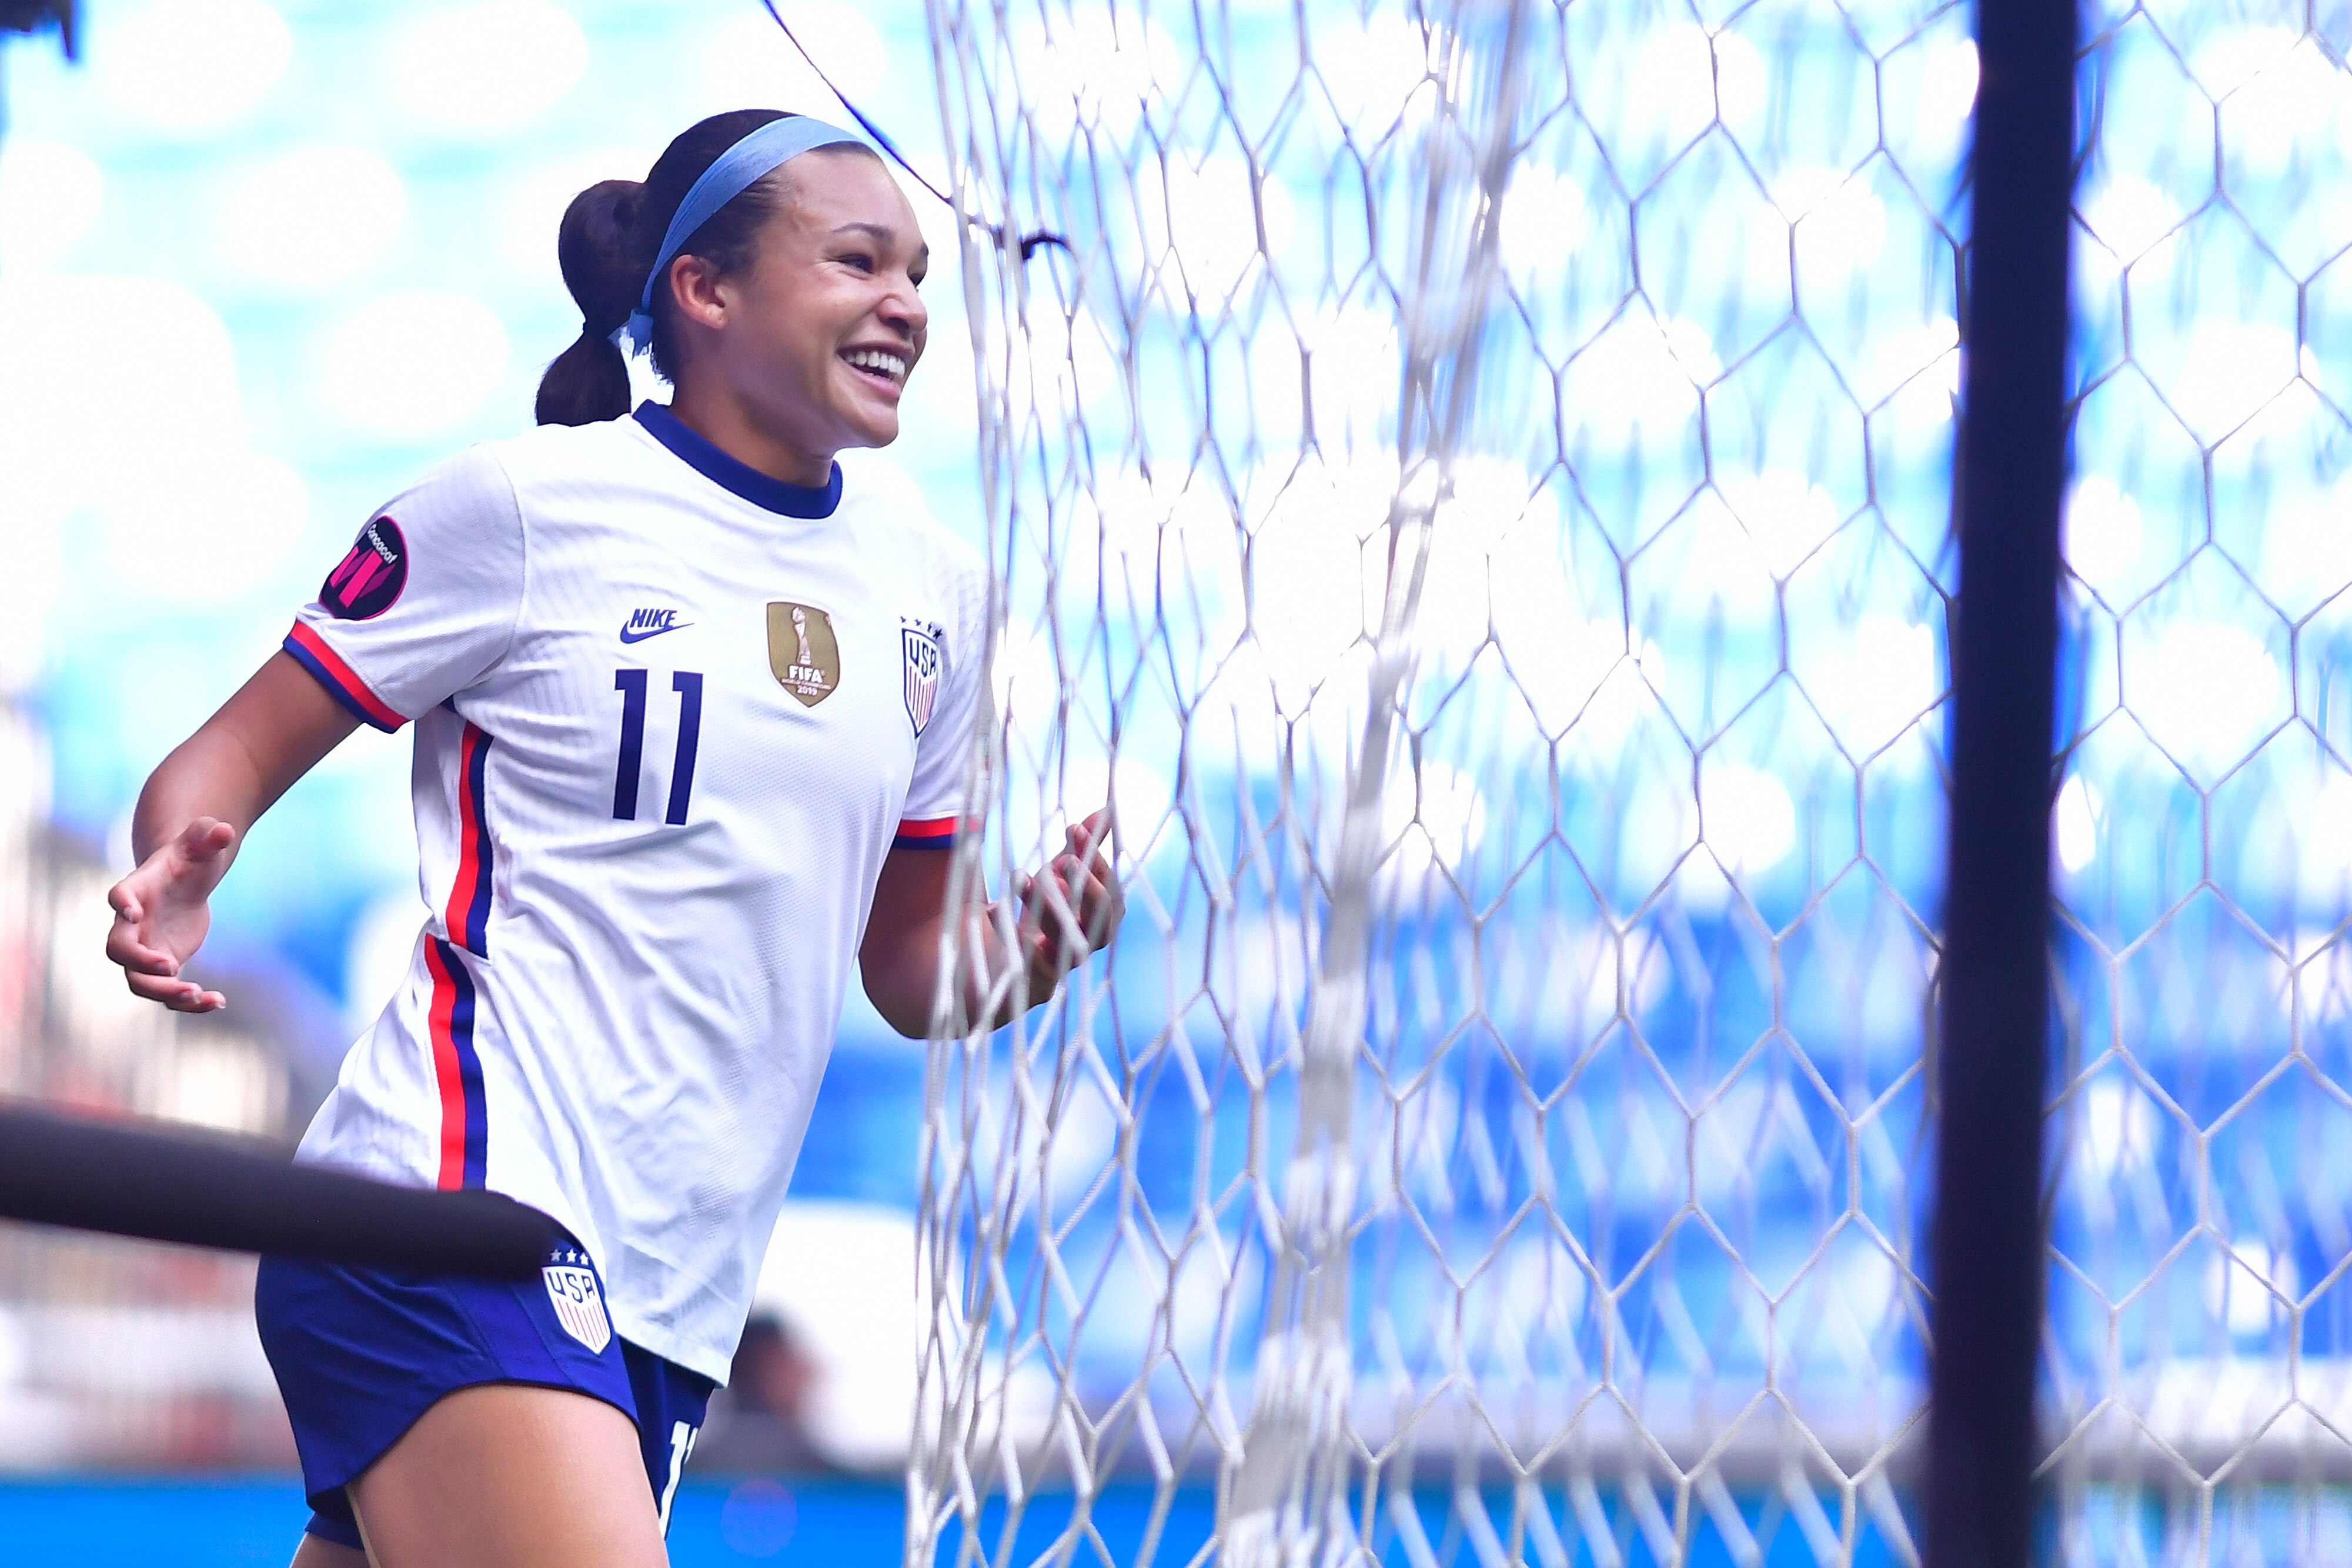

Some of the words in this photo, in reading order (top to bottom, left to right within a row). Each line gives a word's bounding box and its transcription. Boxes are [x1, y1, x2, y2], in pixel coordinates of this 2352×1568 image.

[629, 609, 677, 629] NIKE
[910, 637, 936, 678] USA
[789, 666, 823, 683] FIFA
[613, 668, 703, 825] 11
[547, 1272, 595, 1303] USA
